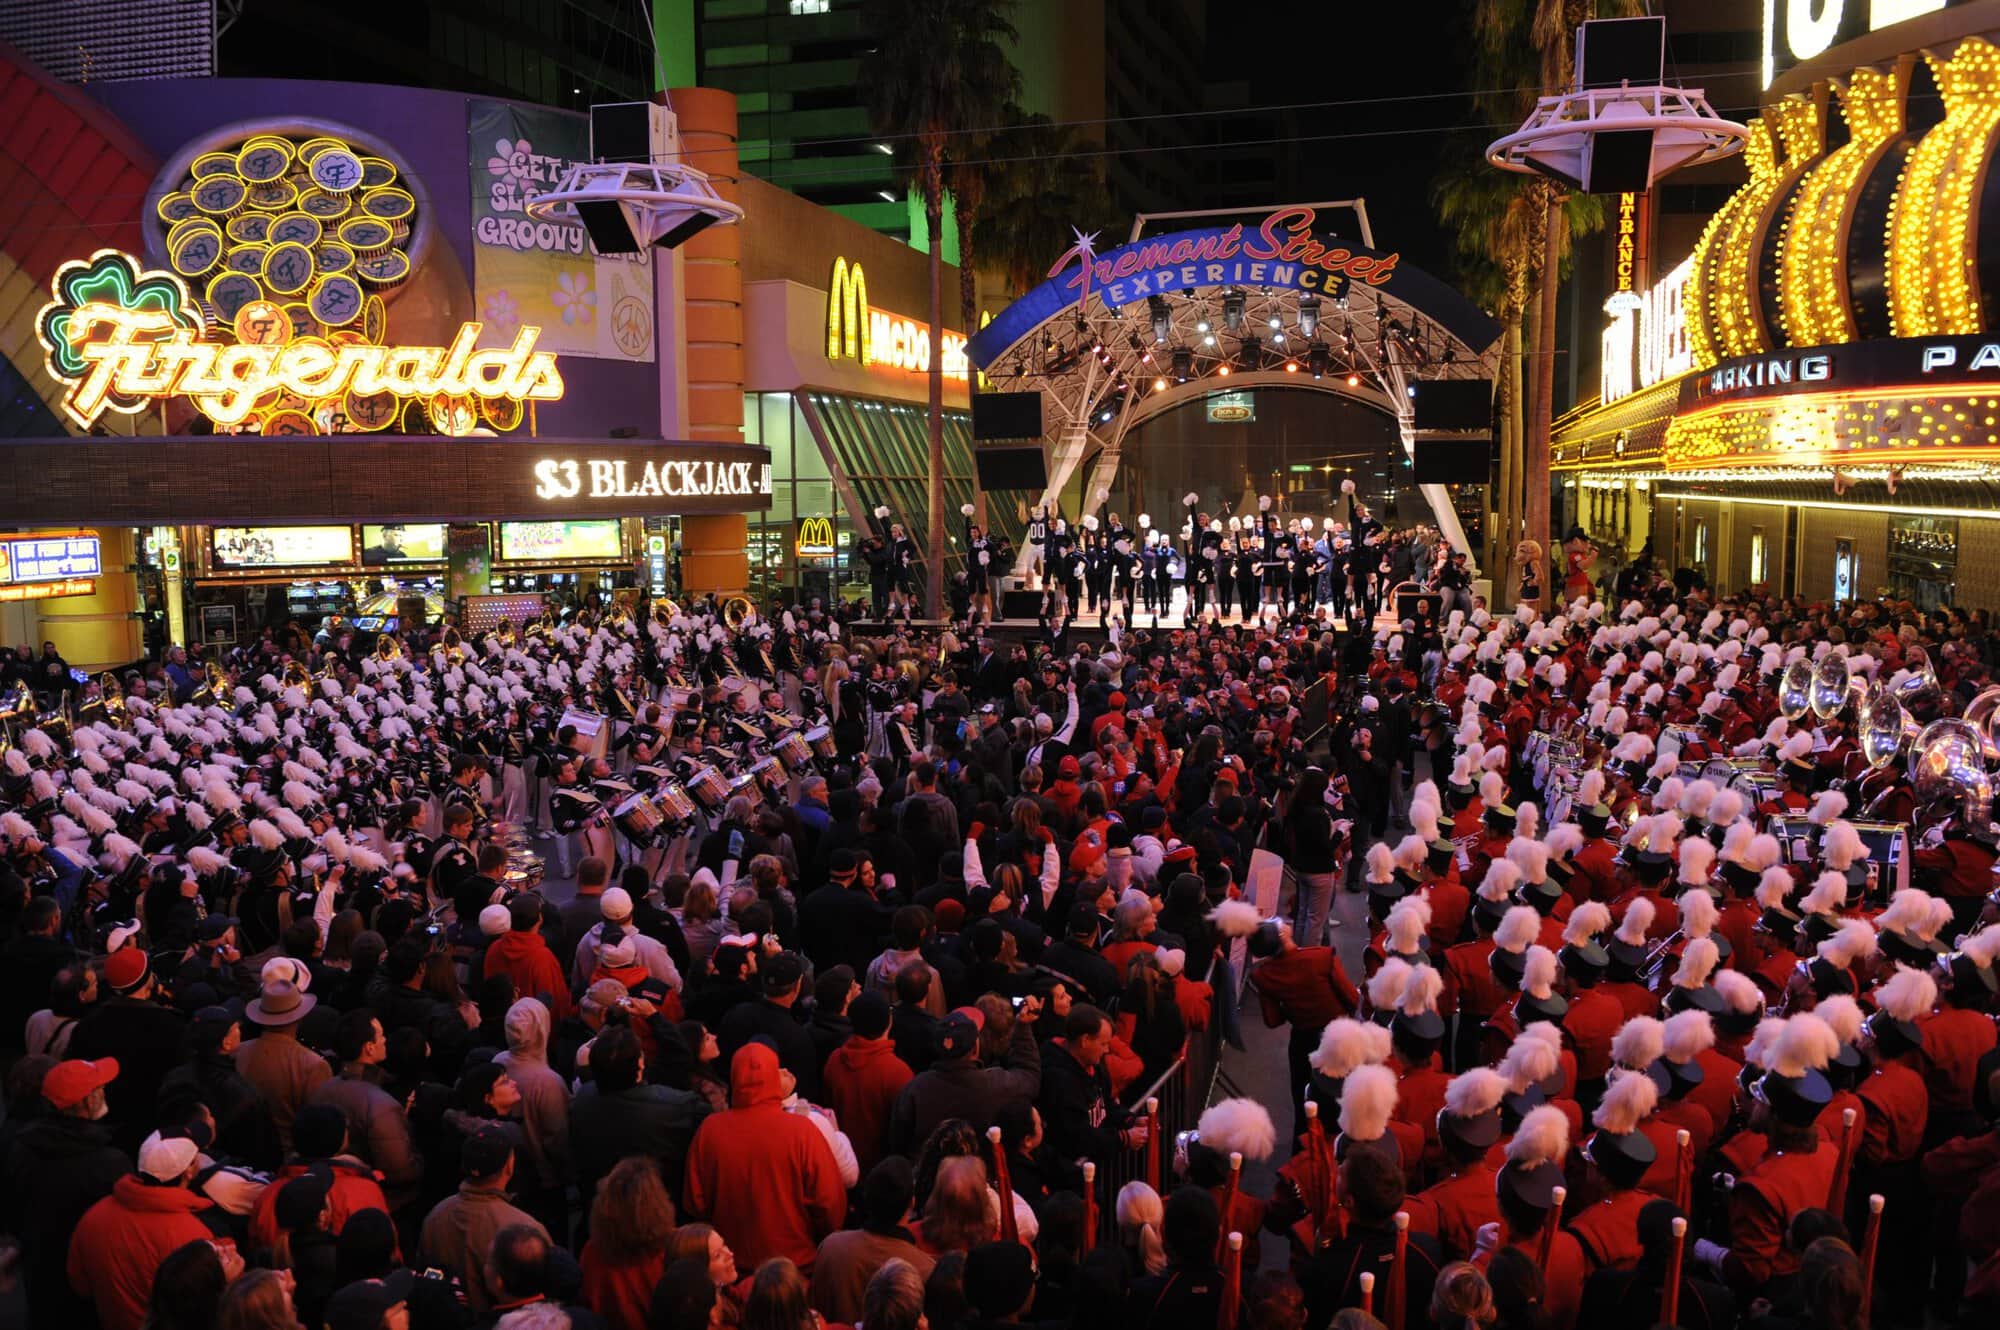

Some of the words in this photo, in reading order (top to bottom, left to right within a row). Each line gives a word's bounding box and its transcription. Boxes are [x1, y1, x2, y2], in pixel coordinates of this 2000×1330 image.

[510, 151, 562, 183] GET
[477, 216, 585, 255] GROOVY
[1617, 192, 1635, 291] NTRANCE
[1047, 223, 1241, 311] Fremont
[1243, 207, 1399, 285] Street
[1109, 262, 1344, 303] EXPERIENCE
[68, 302, 564, 425] Fitzgeralds
[1711, 356, 1828, 393] PARKING
[534, 459, 582, 500] $3
[589, 460, 753, 498] BLACKJACK
[1030, 522, 1045, 539] 00
